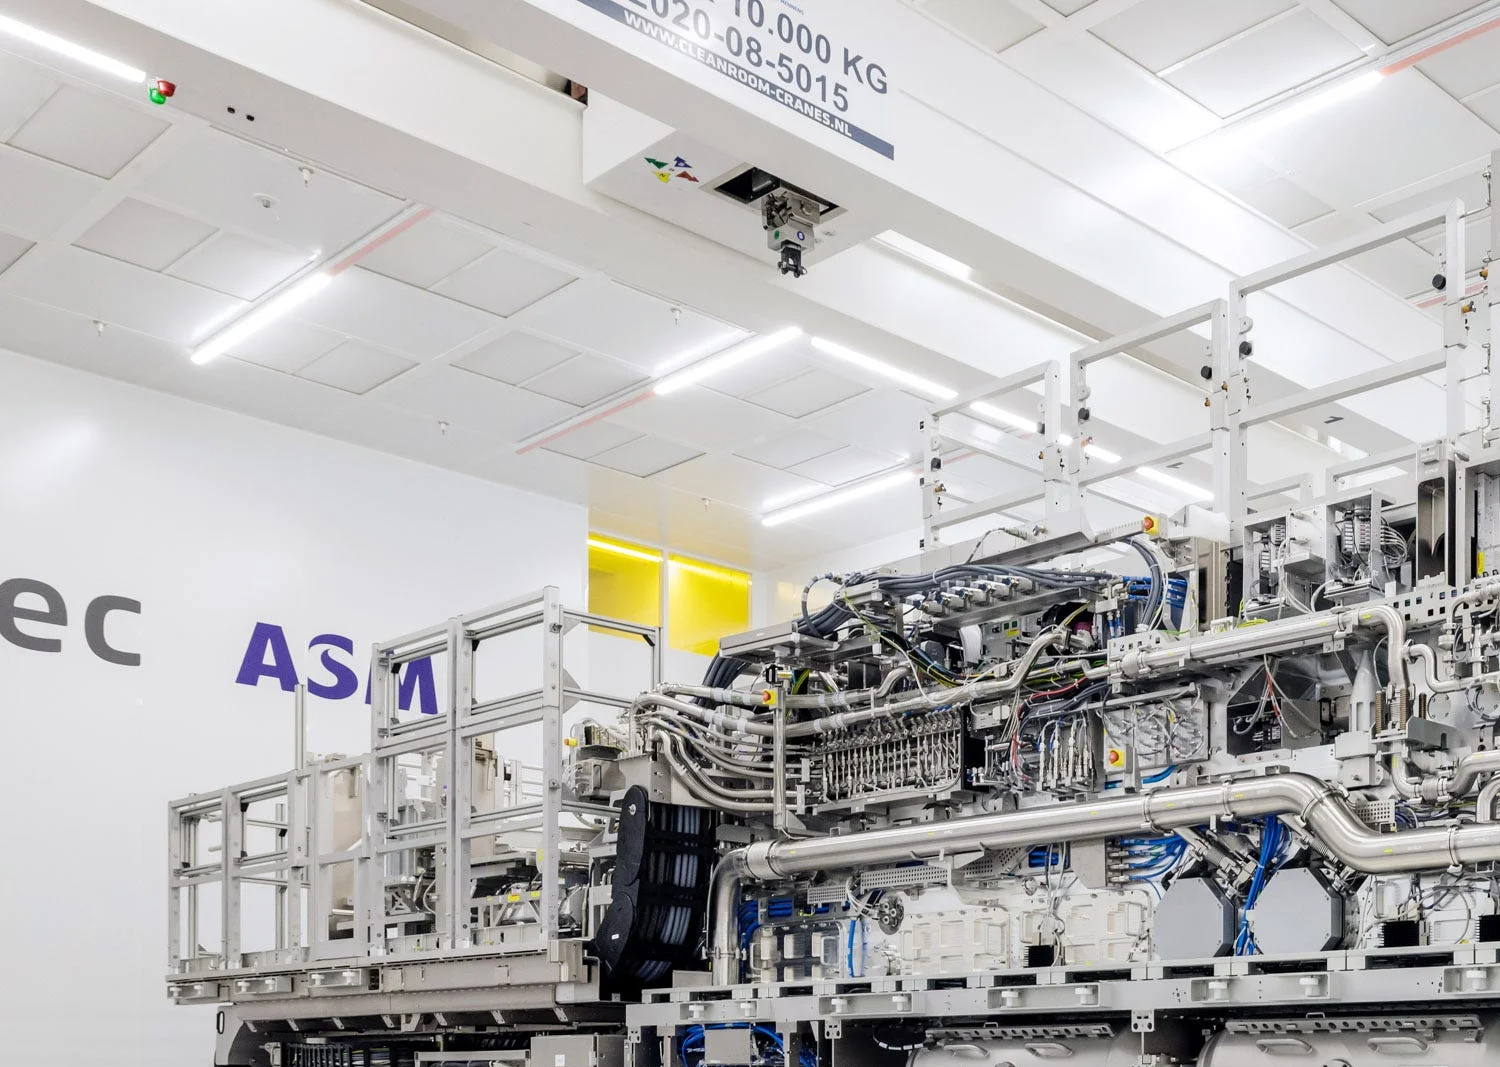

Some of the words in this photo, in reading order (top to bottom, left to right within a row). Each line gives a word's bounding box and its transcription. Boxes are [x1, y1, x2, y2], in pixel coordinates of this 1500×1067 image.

[623, 9, 853, 139] WWW.CLEANROOM-CRANES.NL
[628, 0, 849, 113] 020-08-5015
[733, 0, 832, 64] 10.000
[843, 46, 888, 95] KG
